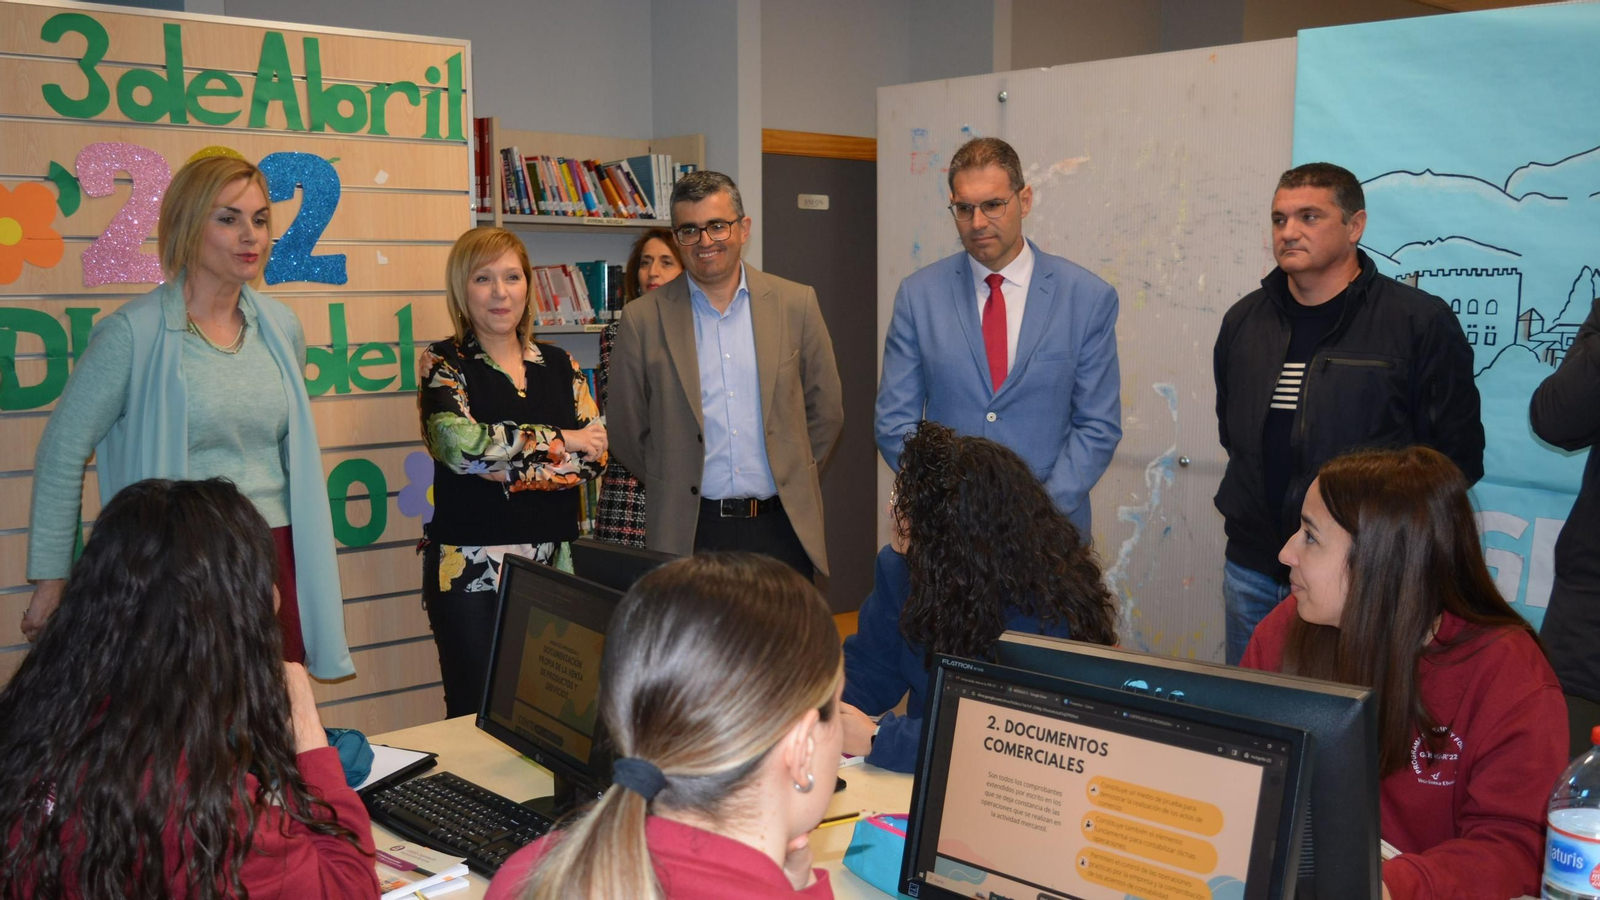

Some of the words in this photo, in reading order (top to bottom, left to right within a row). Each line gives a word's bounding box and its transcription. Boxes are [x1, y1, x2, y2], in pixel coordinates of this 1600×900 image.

[40, 12, 110, 119] 3
[248, 31, 467, 141] Abril
[942, 658, 973, 670] FLATRON
[987, 715, 1000, 731] 2.
[1004, 719, 1109, 757] DOCUMENTOS
[983, 737, 1085, 774] COMERCIALES
[986, 781, 1015, 793] extendidos
[1015, 789, 1025, 797] por
[1026, 792, 1045, 802] escrito
[1053, 798, 1062, 806] los
[988, 771, 998, 779] Son
[998, 774, 1014, 784] todos
[1014, 777, 1022, 786] los
[1023, 781, 1062, 797] comprobantes
[1101, 781, 1128, 794] Constituye
[1137, 791, 1154, 801] medio
[1163, 798, 1182, 809] prueba
[1182, 801, 1197, 812] para
[981, 799, 1013, 813] operaciones
[1013, 808, 1024, 816] que
[1032, 813, 1053, 824] realizan
[984, 790, 995, 798] que
[1003, 795, 1014, 804] deja
[1015, 798, 1043, 811] constancia
[1052, 807, 1061, 816] las
[1099, 791, 1126, 803] demostrar
[1132, 798, 1161, 812] realización
[1161, 806, 1170, 814] de
[1170, 808, 1179, 817] los
[1179, 811, 1194, 821] actos
[1194, 815, 1203, 823] de
[996, 812, 1020, 824] actividad
[1021, 819, 1047, 832] mercantil.
[1095, 816, 1125, 829] Constituye
[1125, 824, 1148, 836] también
[1155, 832, 1183, 846] elemento
[1094, 825, 1129, 840] fundamental
[1128, 835, 1142, 845] para
[1143, 838, 1176, 854] contabilizar
[1176, 847, 1196, 860] dichas
[1090, 851, 1115, 864] Permiten
[1120, 861, 1140, 872] control
[1148, 868, 1158, 877] las
[1158, 872, 1192, 888] operaciones
[1095, 873, 1104, 881] los
[1103, 875, 1125, 887] asientos
[1125, 881, 1134, 889] de
[1112, 868, 1122, 877] por
[1130, 873, 1153, 886] empresa
[1163, 883, 1205, 900] comprobación
